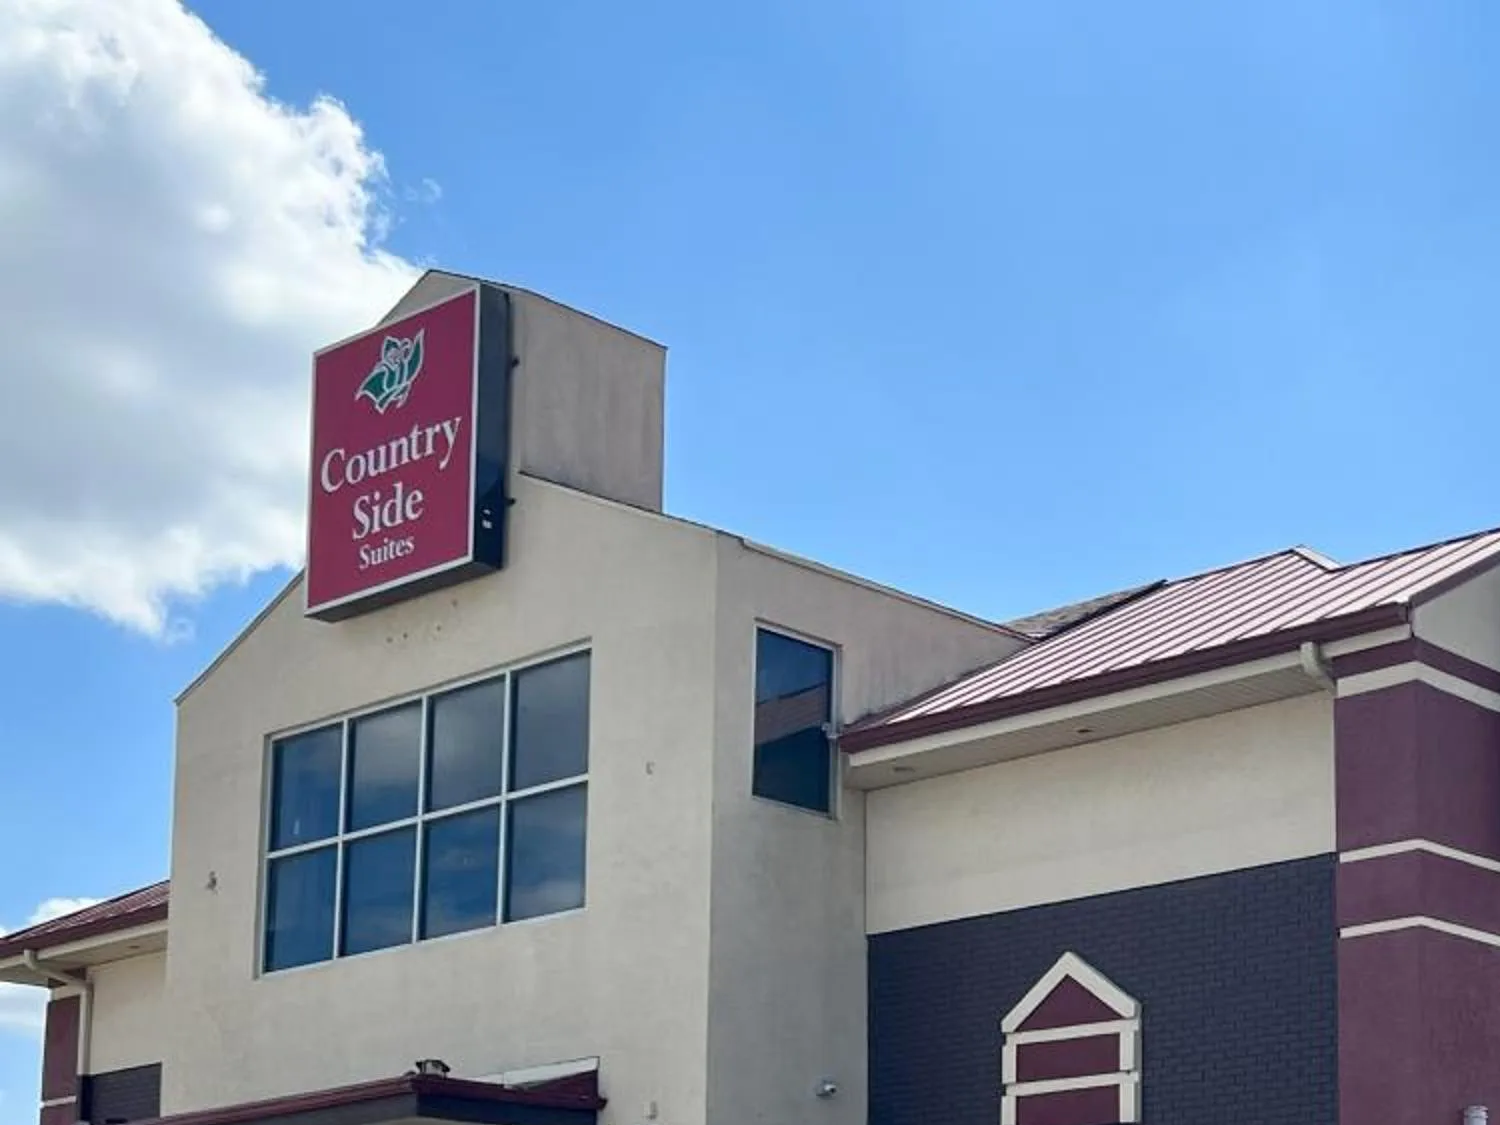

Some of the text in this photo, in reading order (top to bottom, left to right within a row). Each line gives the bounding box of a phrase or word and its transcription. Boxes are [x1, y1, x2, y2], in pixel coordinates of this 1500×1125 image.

[320, 416, 462, 493] Country
[352, 482, 424, 540] Side
[359, 536, 415, 570] Suites
